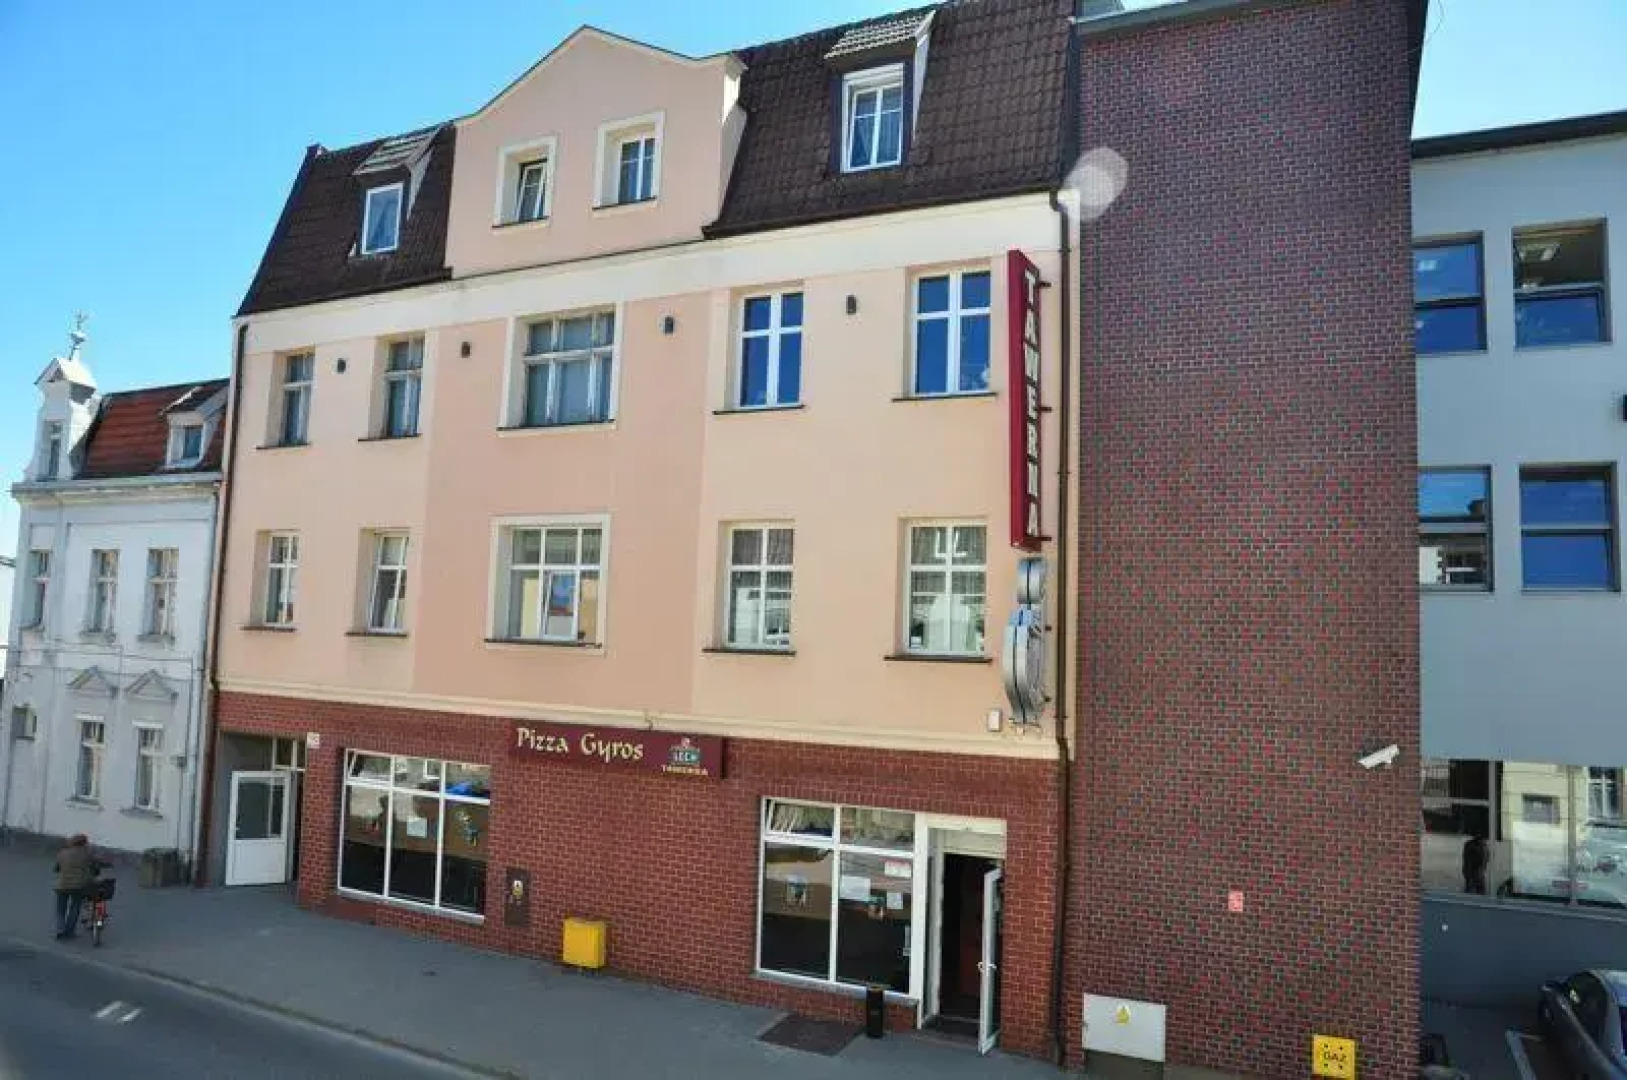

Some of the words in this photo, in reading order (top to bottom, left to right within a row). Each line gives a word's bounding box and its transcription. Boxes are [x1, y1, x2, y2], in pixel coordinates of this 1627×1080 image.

[1023, 269, 1038, 536] TAWERNA
[516, 727, 569, 754] Pizza
[581, 733, 643, 764] Gyros
